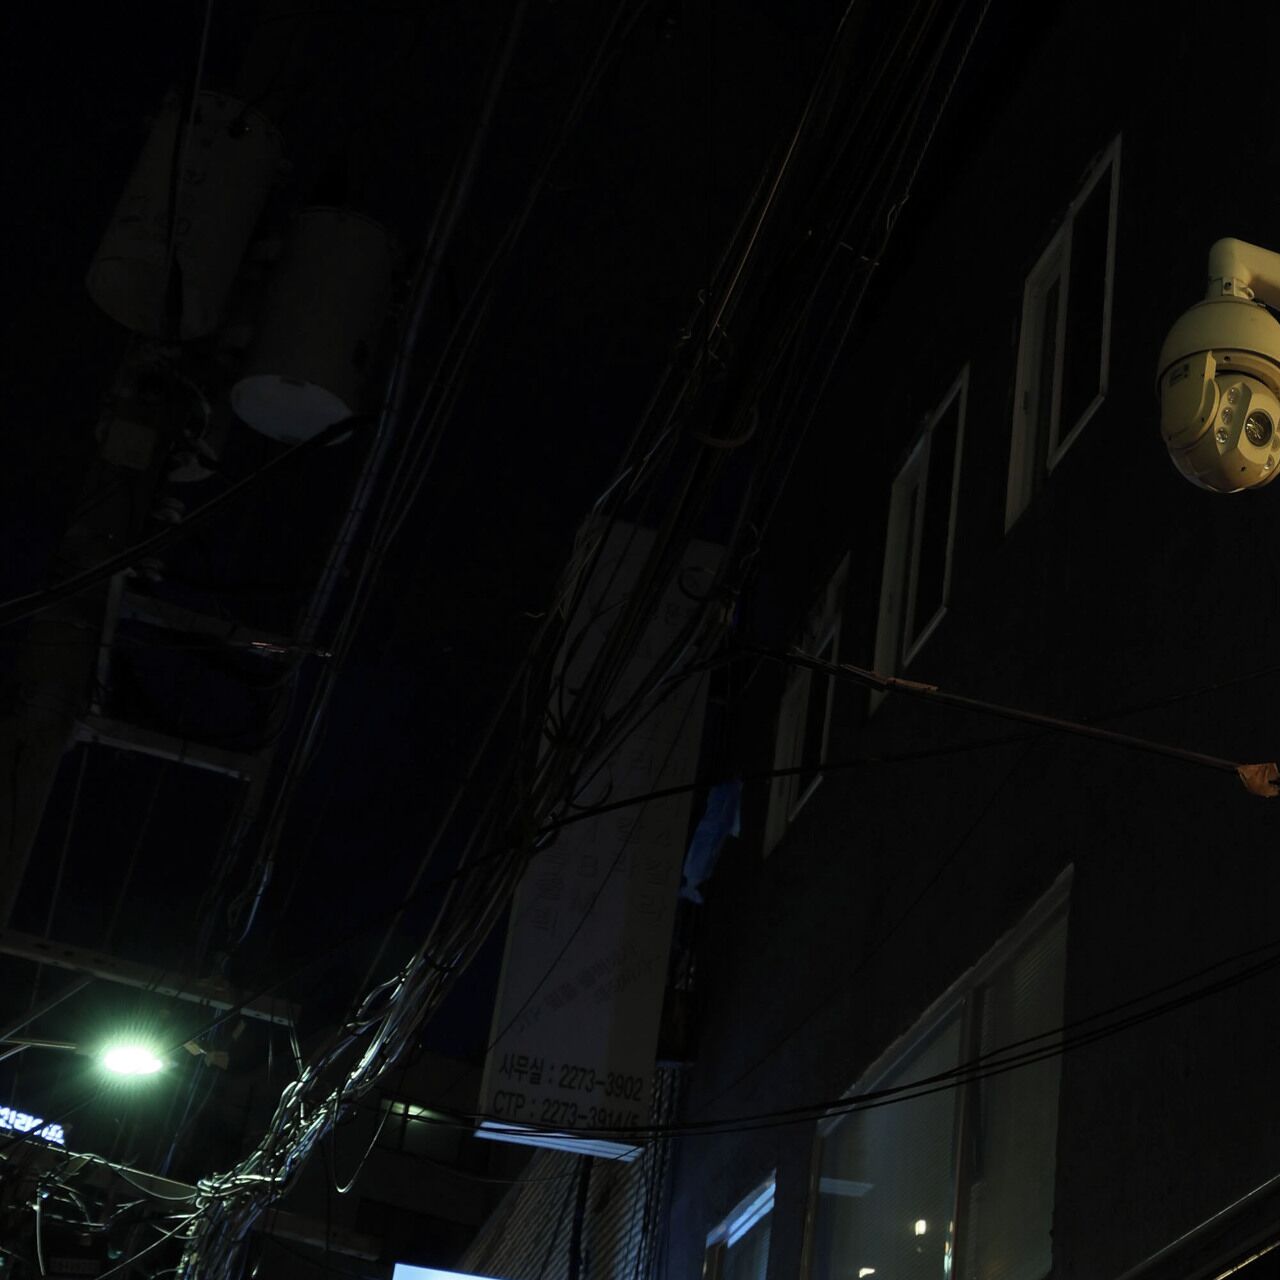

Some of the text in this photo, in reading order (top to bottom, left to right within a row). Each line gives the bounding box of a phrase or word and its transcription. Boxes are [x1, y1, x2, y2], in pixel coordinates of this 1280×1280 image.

[501, 1053, 544, 1085] 사무실
[558, 1064, 643, 1101] 2273-3902
[493, 1090, 525, 1117] CTP
